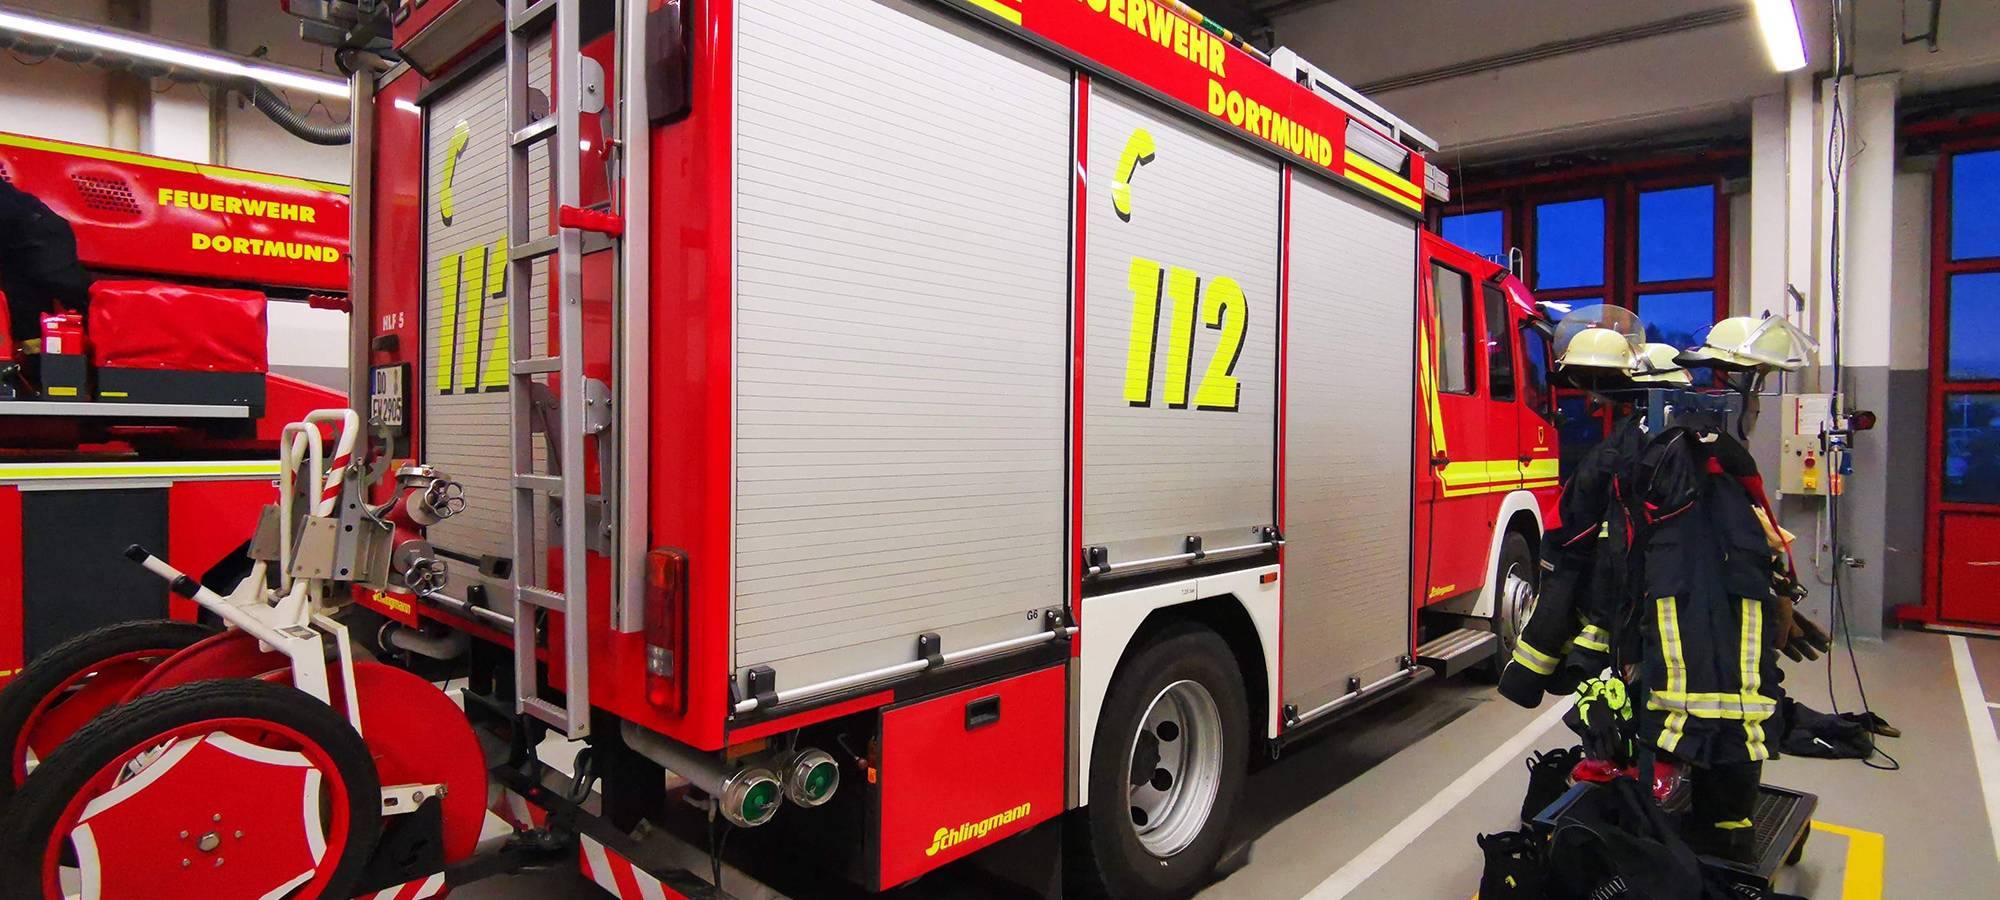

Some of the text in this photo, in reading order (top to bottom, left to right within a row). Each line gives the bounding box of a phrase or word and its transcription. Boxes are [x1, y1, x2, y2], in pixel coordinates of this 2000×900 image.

[1208, 78, 1333, 167] DORTMUND
[157, 187, 316, 223] FEUERWEHR
[191, 232, 340, 263] DORTMUND
[398, 311, 405, 329] 5
[1122, 255, 1249, 413] 112
[1026, 608, 1039, 621] G6
[925, 802, 1031, 857] Schlingmann
